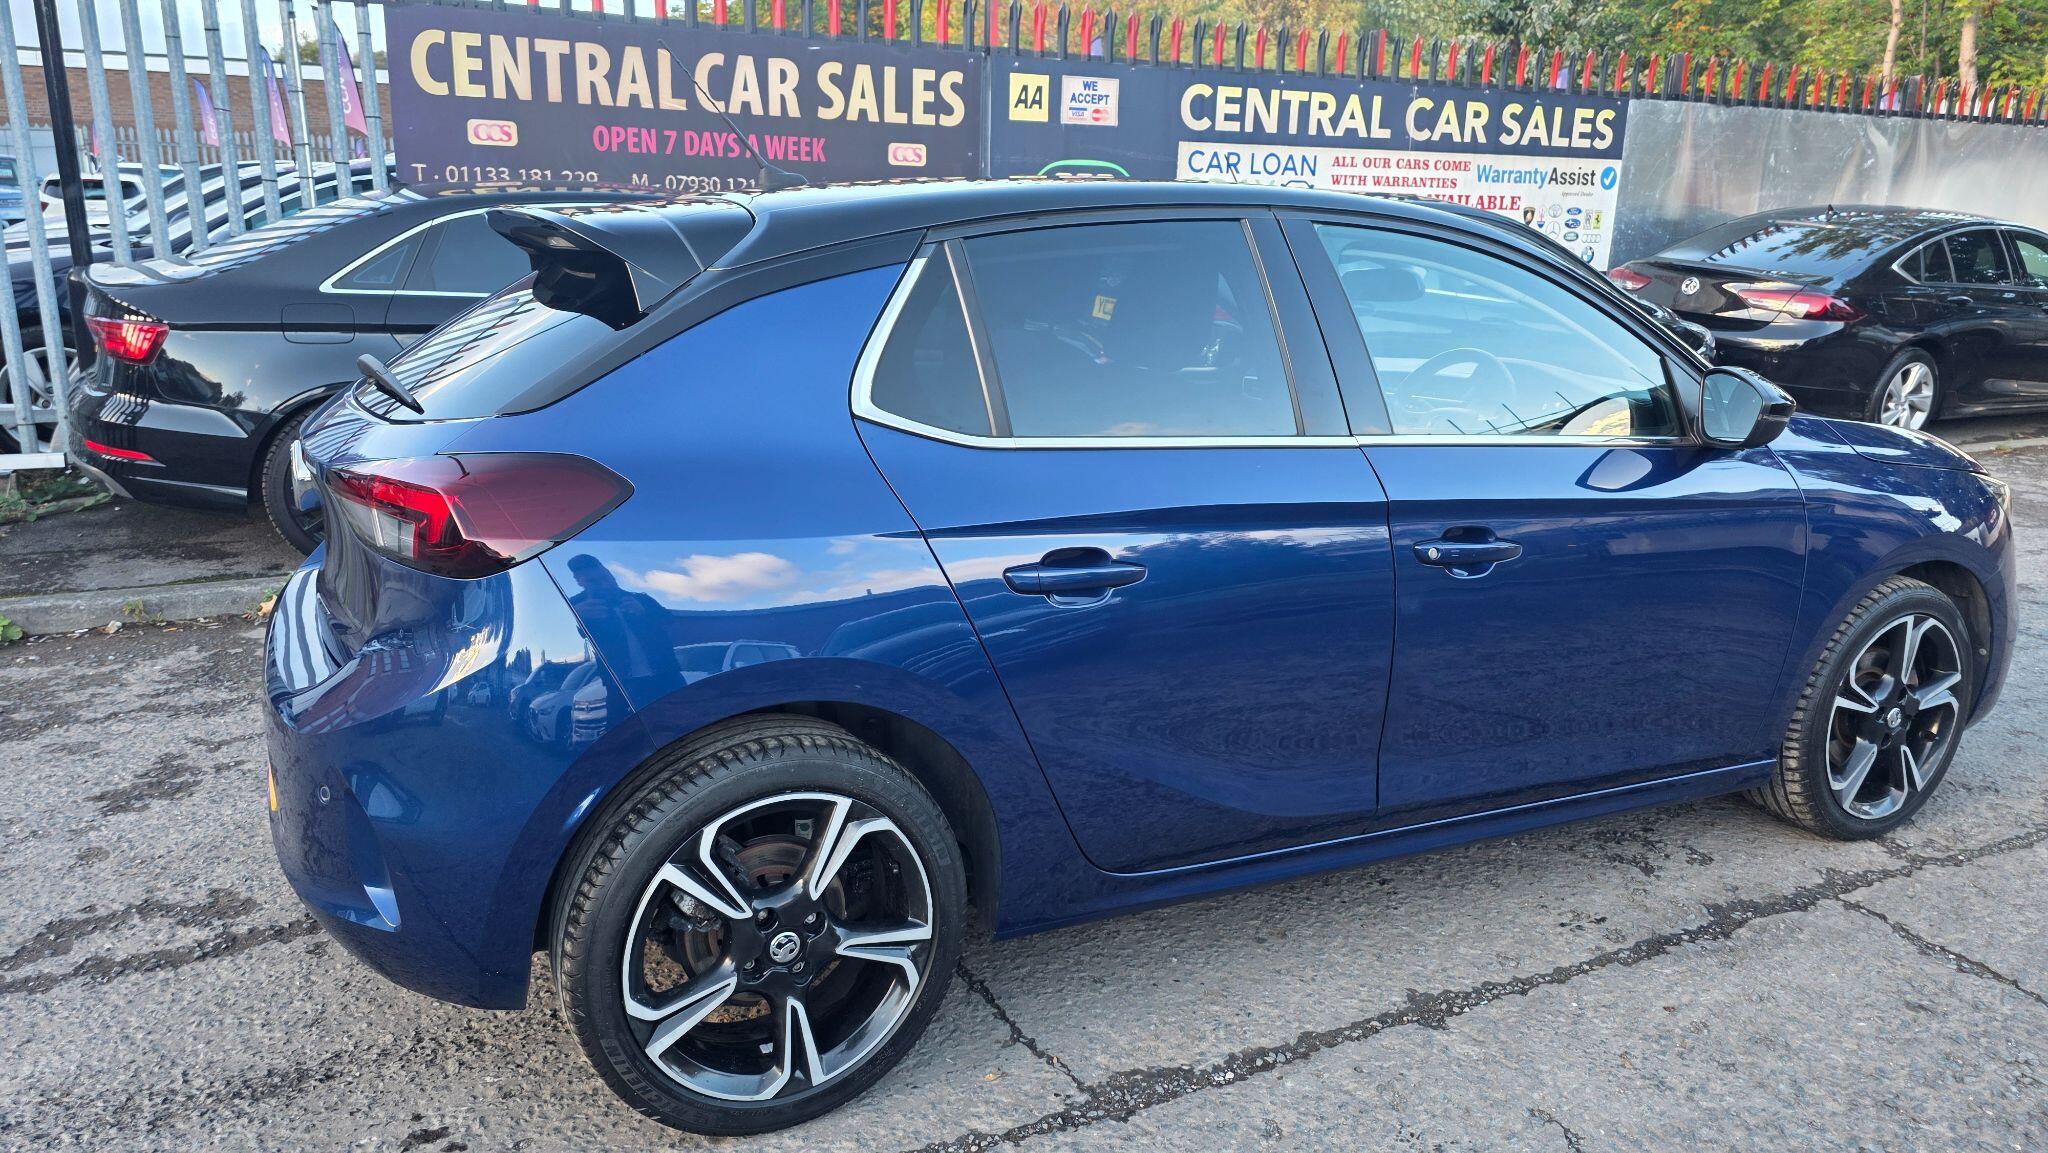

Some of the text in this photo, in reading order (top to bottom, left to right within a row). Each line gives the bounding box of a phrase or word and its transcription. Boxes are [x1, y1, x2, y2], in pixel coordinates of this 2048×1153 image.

[410, 29, 688, 111] CENTRAL
[694, 52, 801, 118] CAR
[816, 61, 965, 127] SALES
[1082, 80, 1098, 91] WE
[1014, 84, 1043, 110] AA
[1069, 93, 1110, 105] ACCEPT
[1180, 83, 1617, 150] CENTRAL CAR SALES
[592, 125, 826, 162] OPEN 7 DAYS A WEEK
[1188, 150, 1318, 177] CAR LOAN
[1332, 156, 1472, 172] ALL OUR CARS COME
[445, 165, 510, 183] 01133
[1331, 174, 1458, 189] WITH WARRANTIES
[665, 175, 720, 192] 07930
